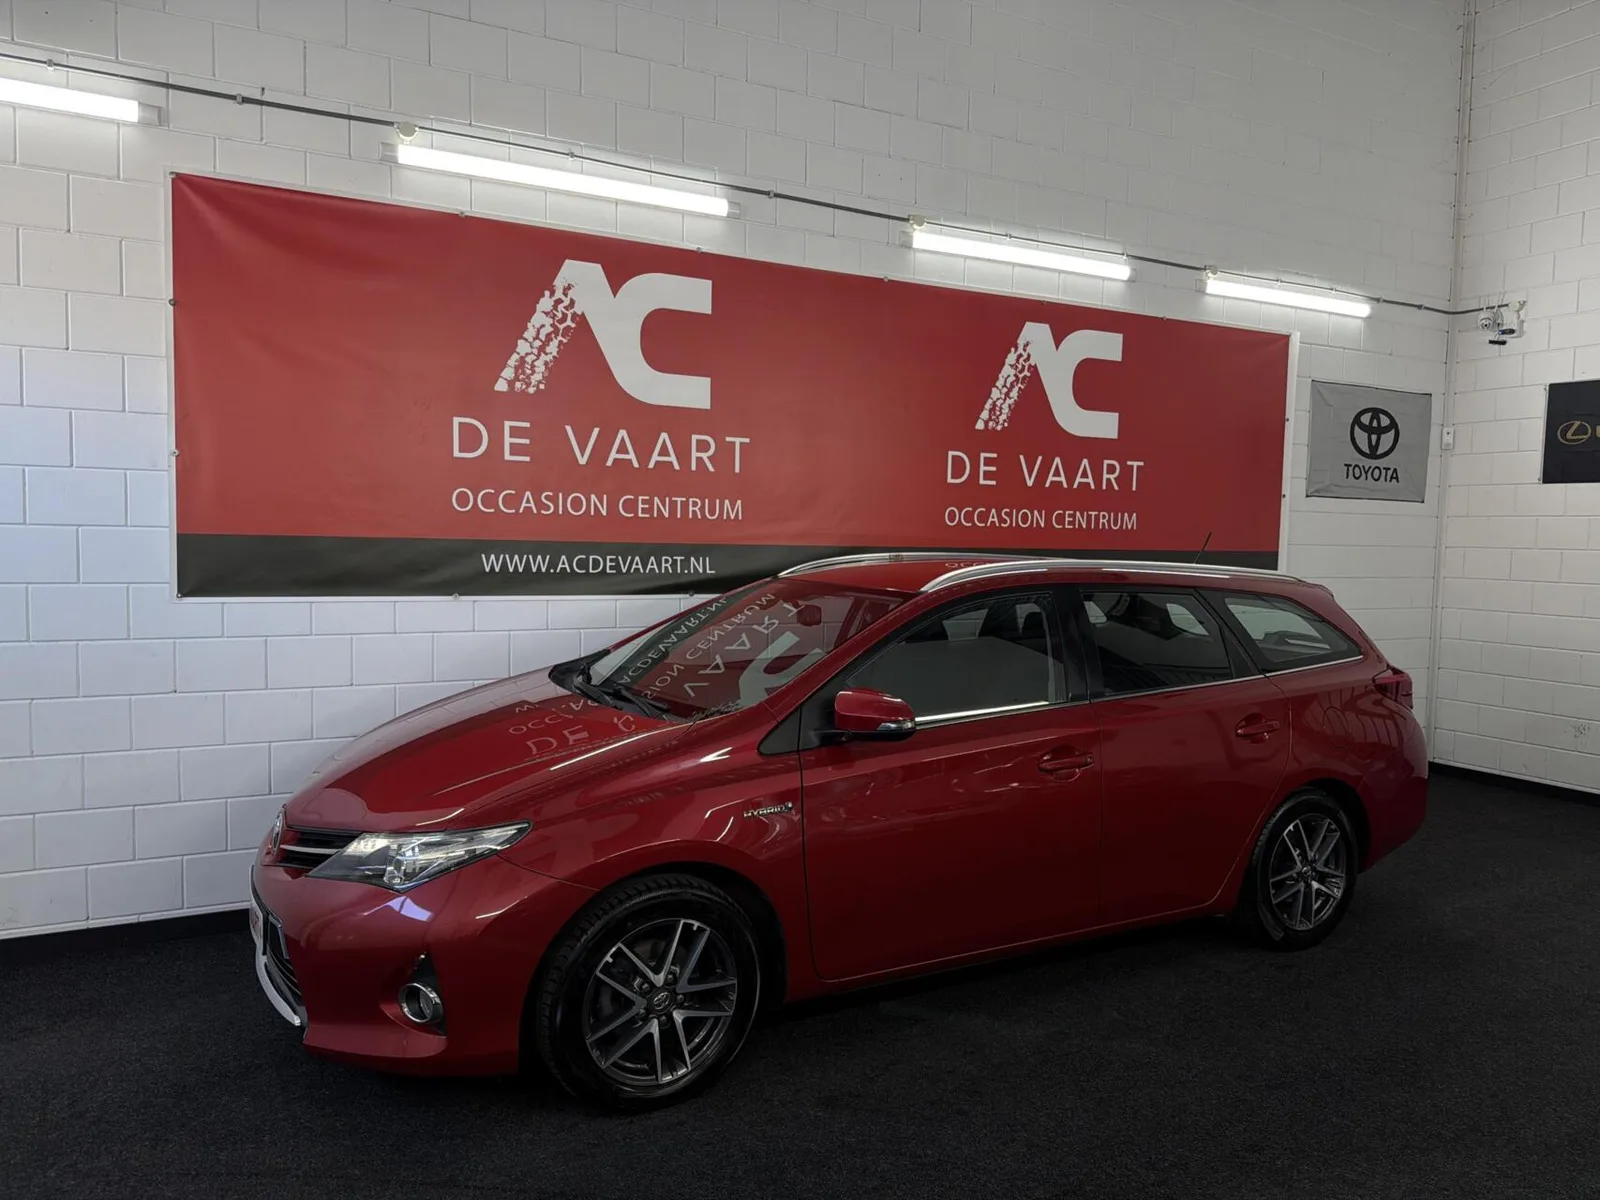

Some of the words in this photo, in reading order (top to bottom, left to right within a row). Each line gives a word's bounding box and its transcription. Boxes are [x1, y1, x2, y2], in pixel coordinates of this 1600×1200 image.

[452, 416, 531, 462] DE
[565, 424, 750, 473] VAART
[946, 450, 998, 486] DE
[1019, 454, 1144, 491] VAART
[1344, 463, 1399, 483] TOYOTA
[451, 488, 607, 516] OCCASION
[618, 495, 743, 520] CENTRUM
[944, 506, 1045, 528] OCCASION
[1052, 510, 1137, 530] CENTRUM
[481, 553, 716, 574] WWW.ACDEVAART.NL
[743, 804, 786, 818] HYBRID
